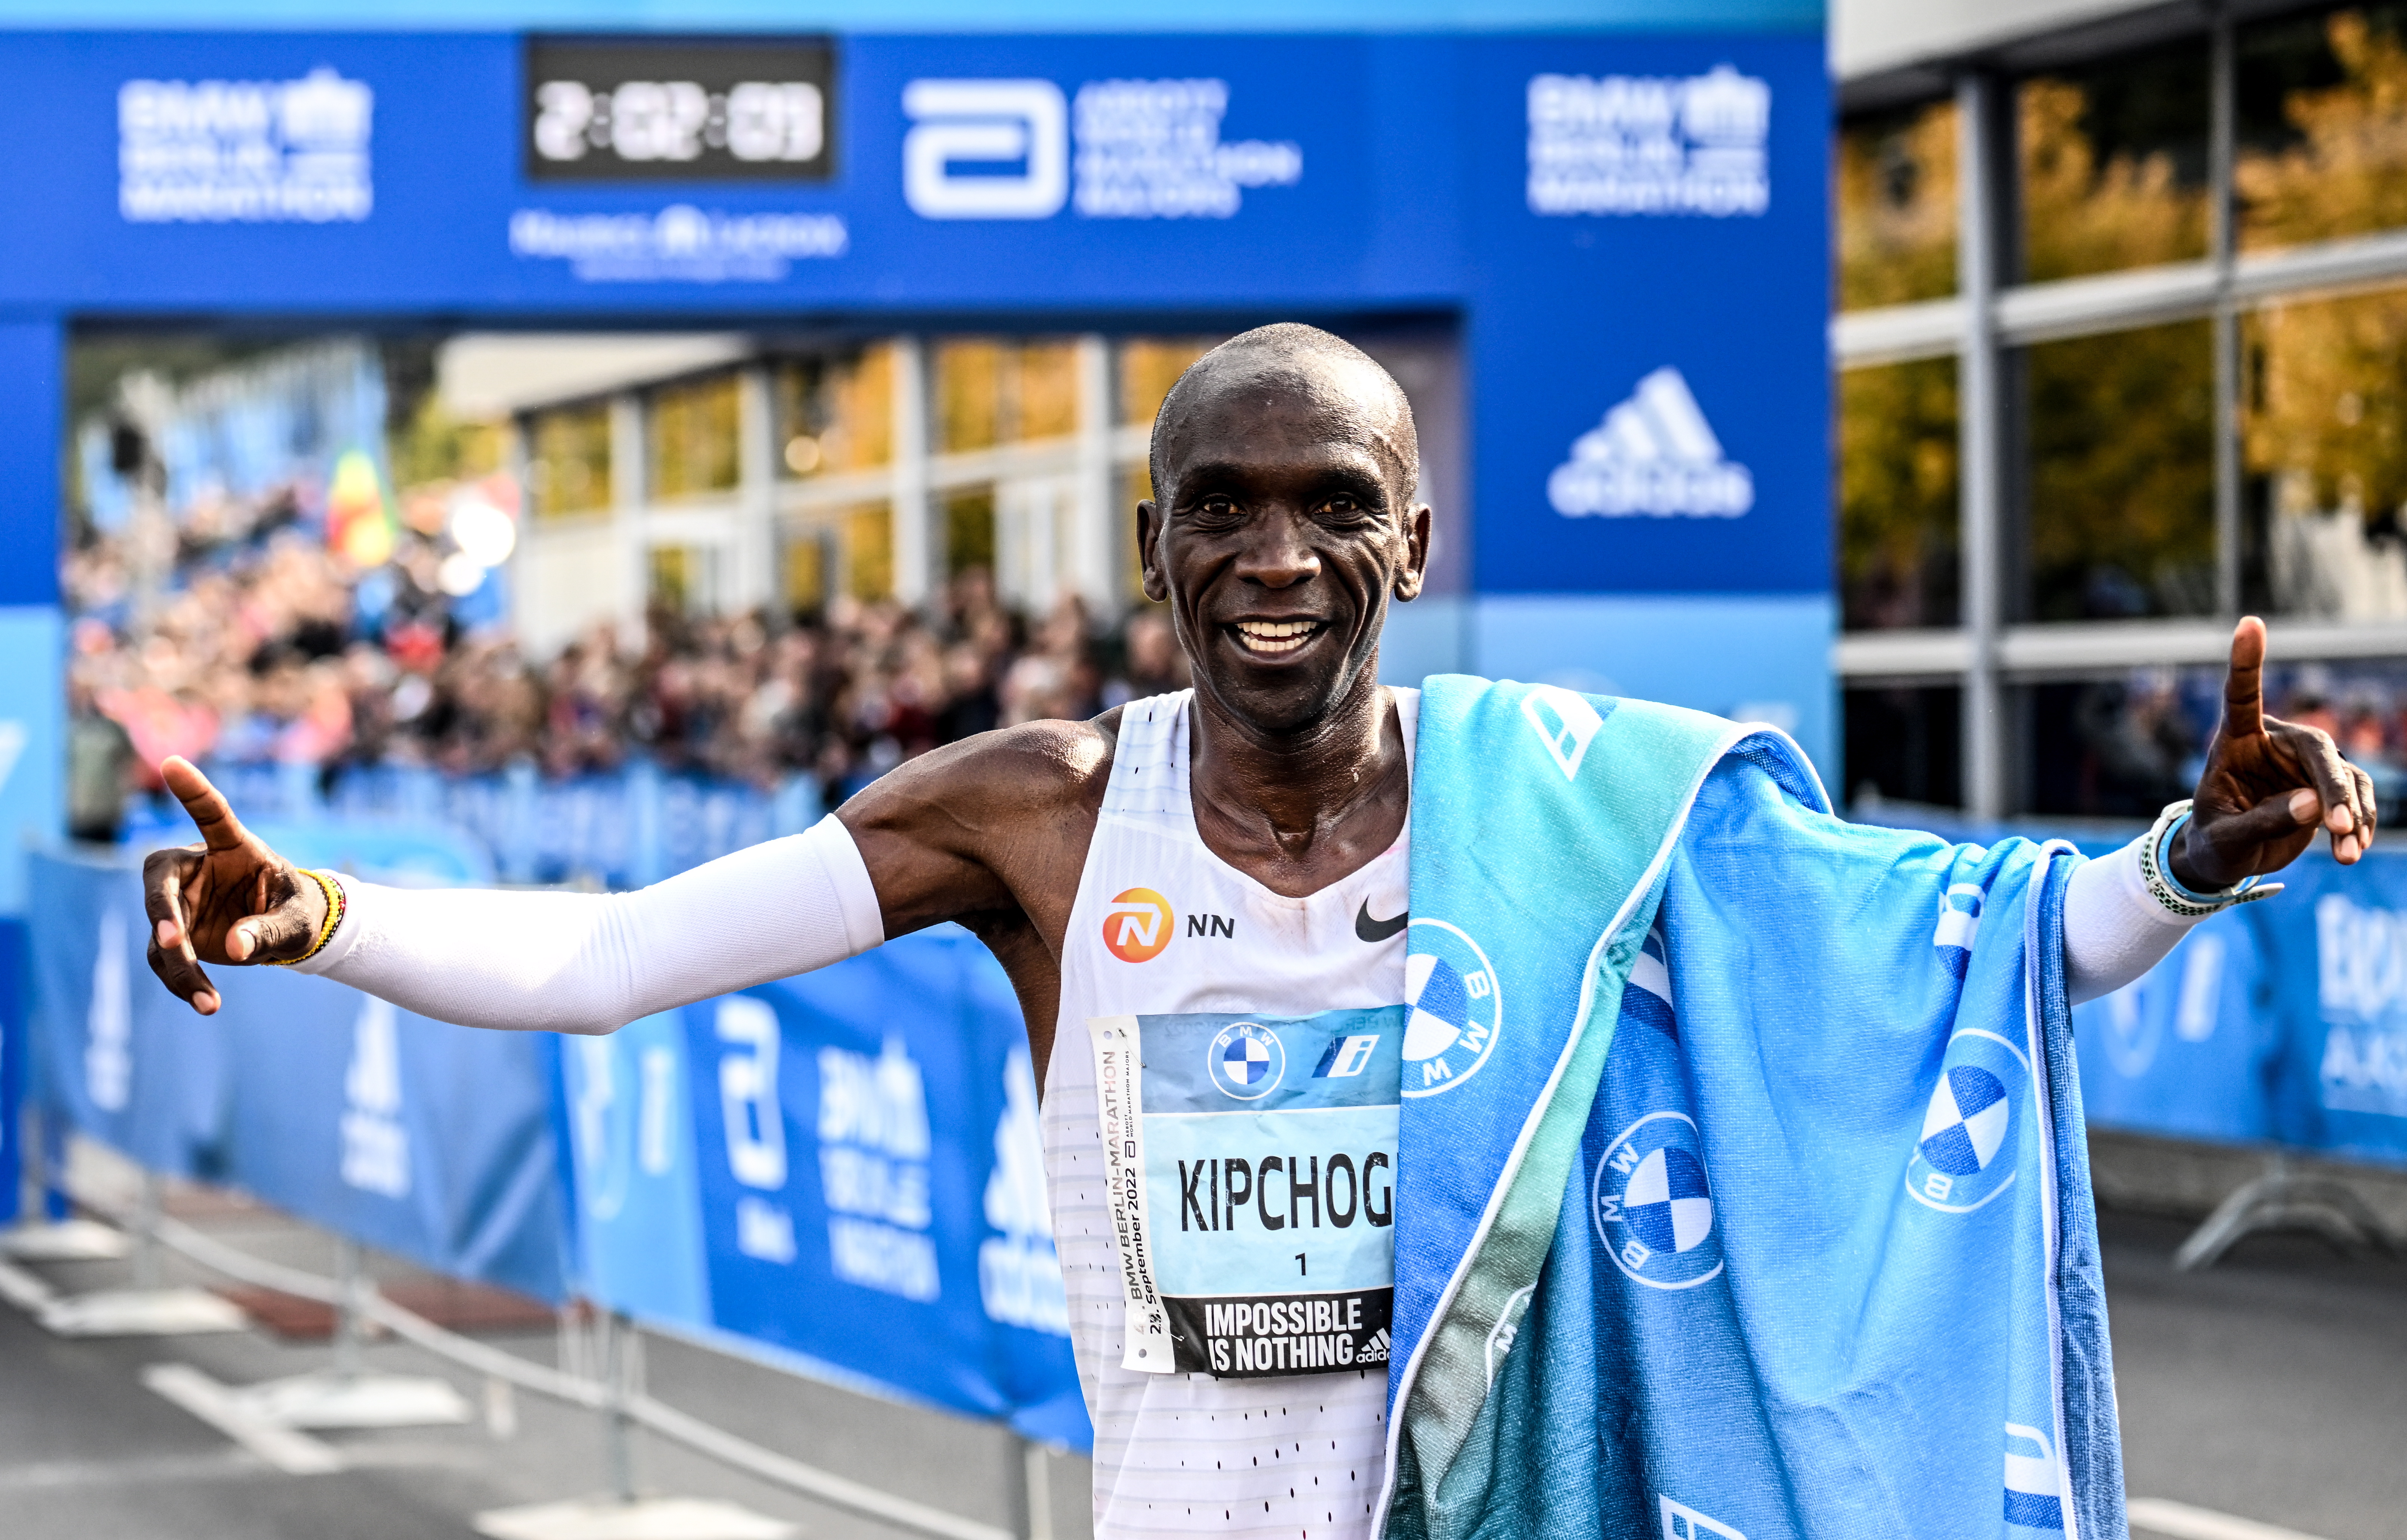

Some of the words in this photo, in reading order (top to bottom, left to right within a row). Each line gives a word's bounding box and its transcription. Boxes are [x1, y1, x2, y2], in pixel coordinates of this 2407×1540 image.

[537, 82, 821, 159] 2:02:09
[1187, 914, 1235, 939] NN
[1103, 1051, 1130, 1248] BERLIN-MARATHON
[1125, 1168, 1138, 1211] 2022
[1178, 1152, 1399, 1232] KIPCHOG
[1123, 1252, 1143, 1300] BMW
[1131, 1214, 1157, 1305] September
[1295, 1253, 1306, 1276] 1
[1205, 1298, 1362, 1336] IMPOSSIBLE
[1208, 1338, 1230, 1371] IS
[1236, 1335, 1353, 1371] NOTHING
